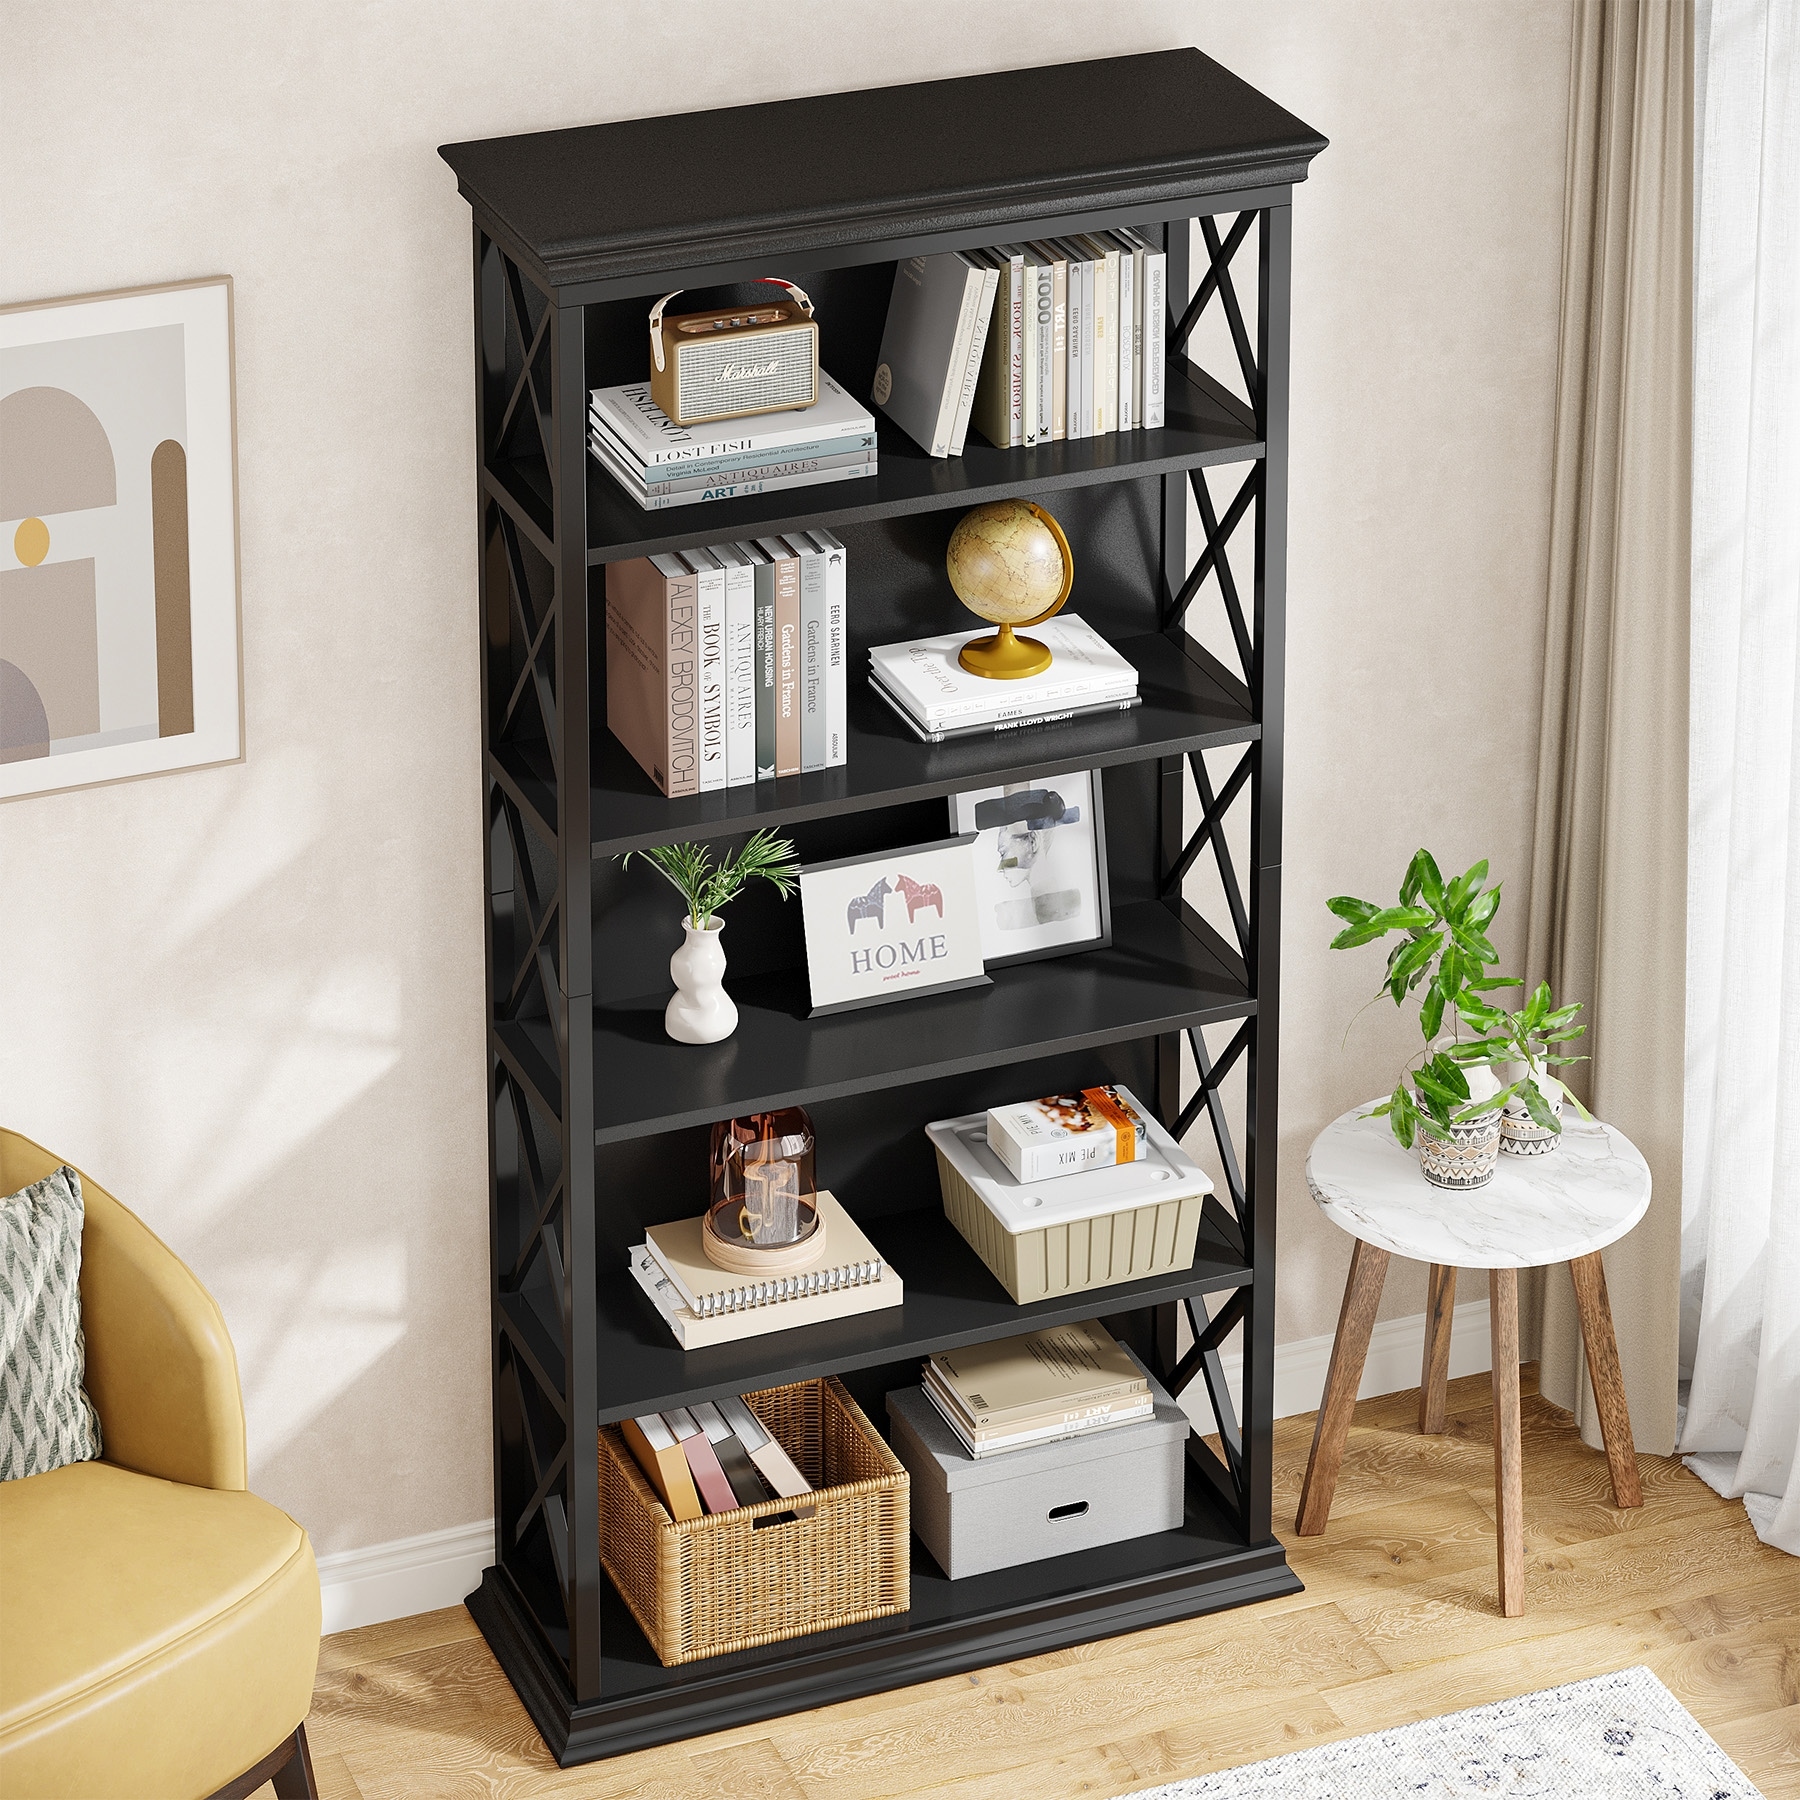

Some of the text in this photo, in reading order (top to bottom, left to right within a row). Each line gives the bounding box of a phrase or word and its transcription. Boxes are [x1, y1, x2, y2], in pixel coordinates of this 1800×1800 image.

[714, 360, 779, 383] Marshall
[655, 439, 752, 463] LOST FISH
[666, 463, 686, 472] Detail
[694, 455, 742, 468] Contemporary
[742, 450, 780, 460] Residential
[780, 444, 820, 455] Architecture
[693, 465, 720, 474] McLeod
[706, 459, 819, 484] ANTIQUAIRES
[701, 485, 738, 501] ART
[703, 604, 711, 621] THE
[703, 623, 721, 669] BOOK
[764, 605, 774, 688] NEW URBAN HOUSING
[831, 604, 841, 667] EERO SAARINEN
[704, 671, 712, 681] OF
[737, 622, 752, 731] ANTIQUAIRES
[781, 623, 795, 718] Gardens in France
[807, 620, 820, 714] Gardens in France
[670, 583, 695, 785] ALEXEY BRODOVITCH
[703, 683, 722, 762] SYMBOLS
[994, 711, 1074, 732] FRANK LLOYD WRIGHT
[997, 709, 1023, 718] EAMES
[851, 934, 949, 974] HOME
[1017, 1113, 1033, 1125] MIX
[1026, 1125, 1042, 1135] PIE
[1059, 1146, 1096, 1165] PIE MIX
[1083, 1404, 1112, 1418] ART
